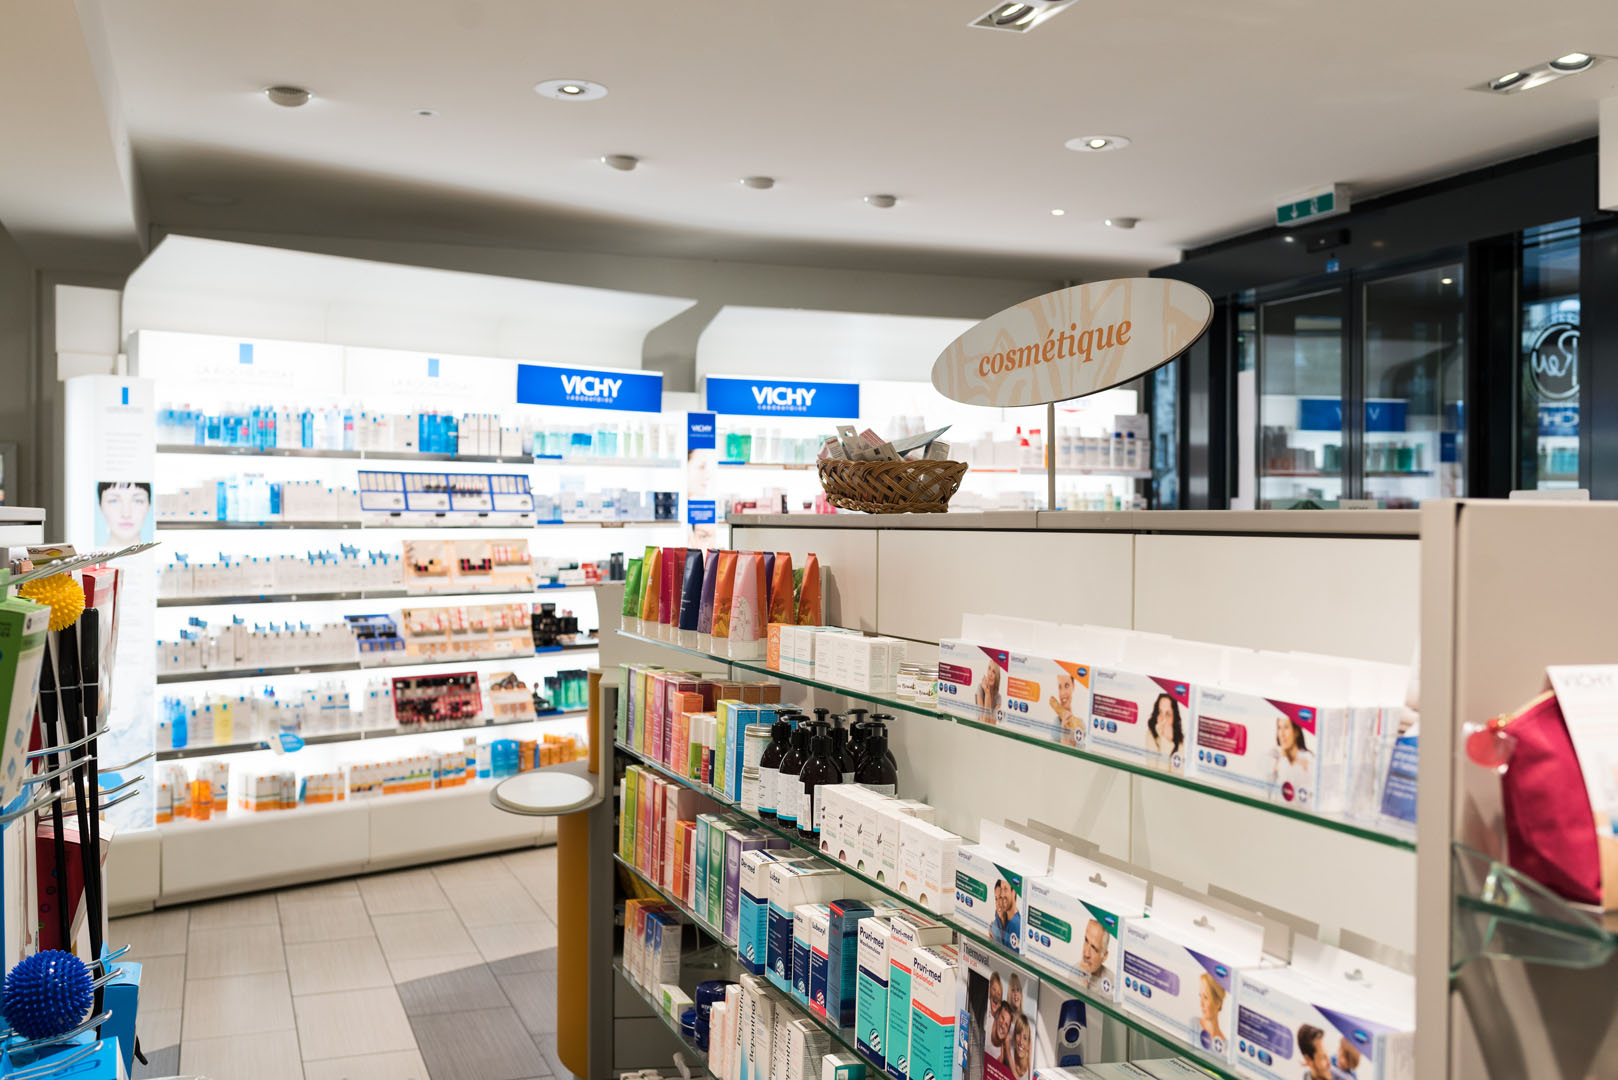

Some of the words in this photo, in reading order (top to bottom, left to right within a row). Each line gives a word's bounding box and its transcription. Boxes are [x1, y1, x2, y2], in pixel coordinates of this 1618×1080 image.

[978, 319, 1132, 377] cosmétique
[561, 374, 622, 398] VICHY
[751, 385, 816, 407] VICHY
[859, 926, 885, 949] Pruri-med
[890, 924, 914, 942] Pruri-med
[913, 957, 942, 983] Pruri-med
